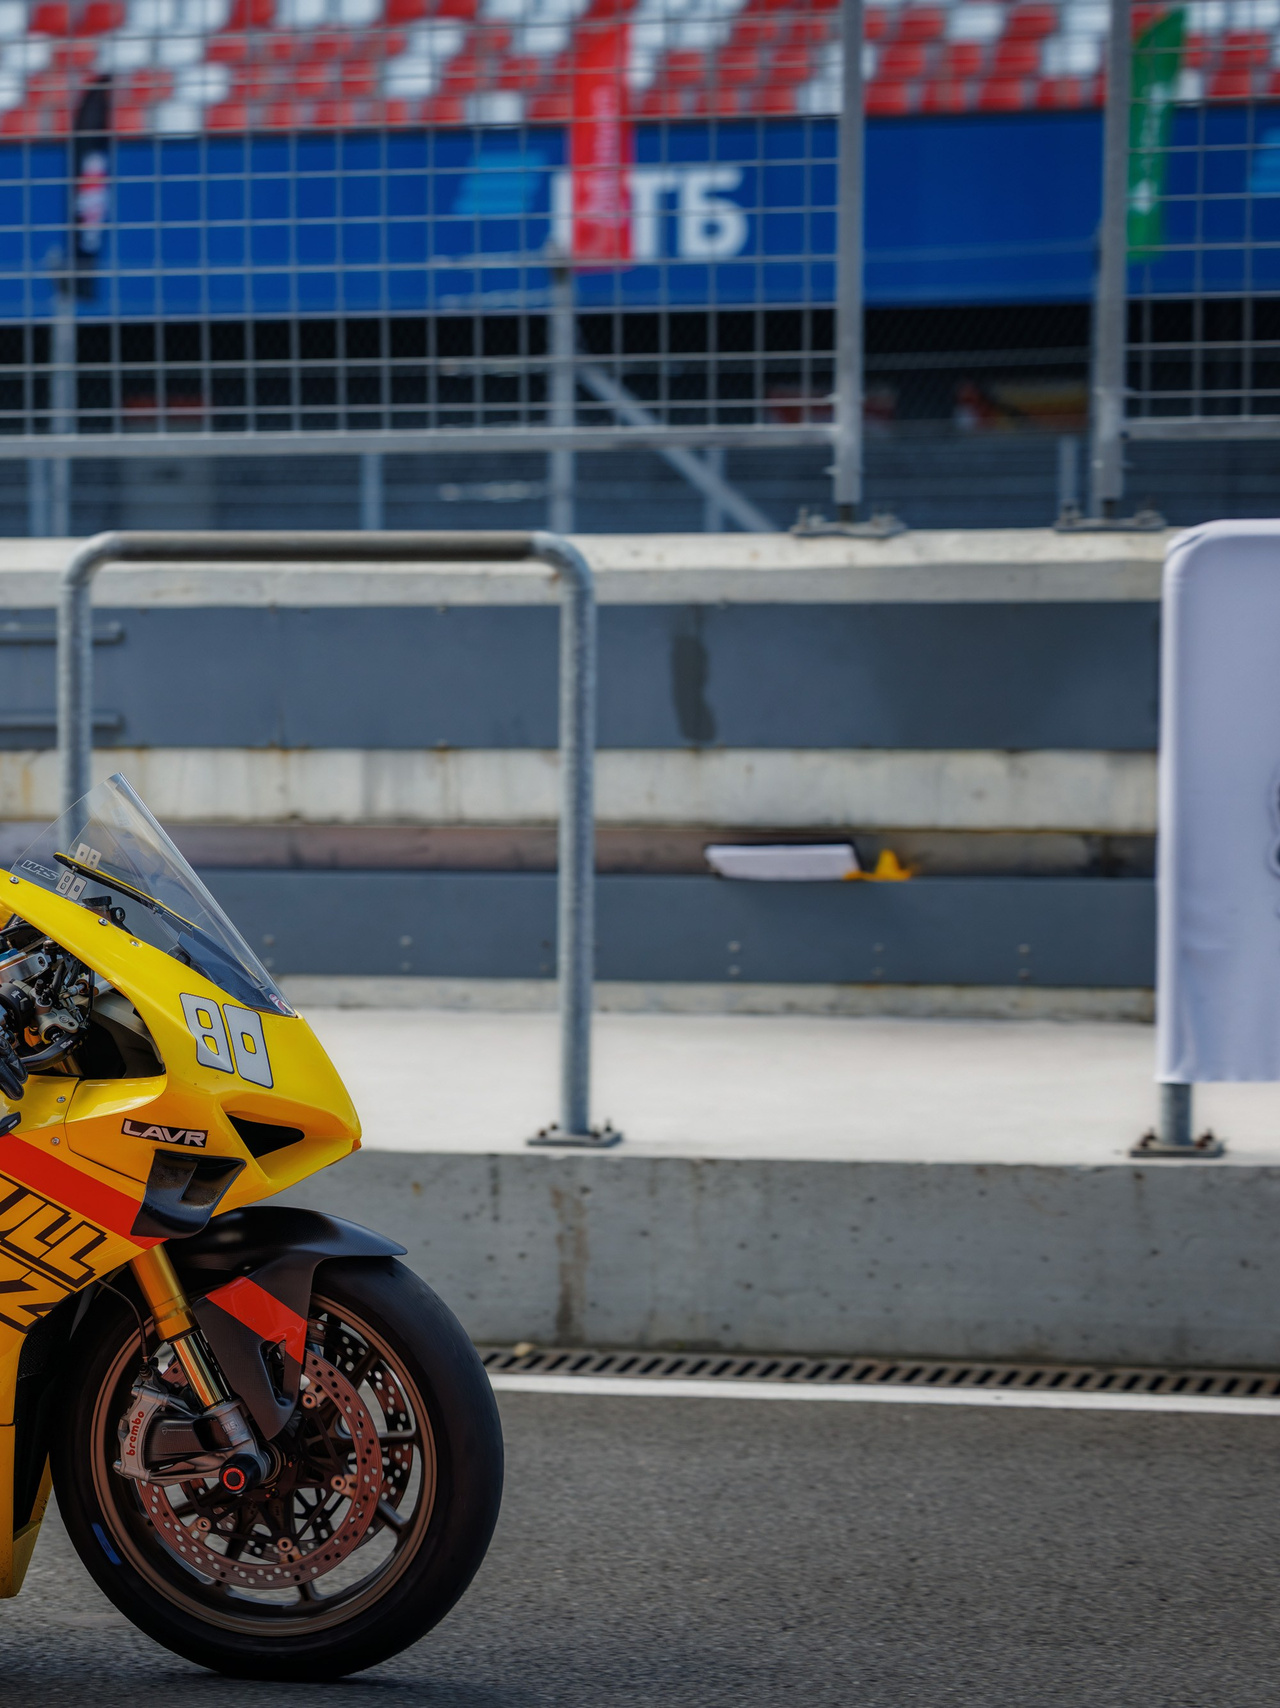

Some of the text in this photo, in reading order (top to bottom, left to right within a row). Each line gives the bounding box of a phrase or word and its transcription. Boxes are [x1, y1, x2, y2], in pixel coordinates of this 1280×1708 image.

[551, 164, 748, 262] ТБ
[20, 859, 60, 881] WRS
[55, 869, 88, 901] 80
[179, 992, 274, 1089] 80
[122, 1119, 206, 1147] LAVR
[125, 1410, 145, 1457] brembo
